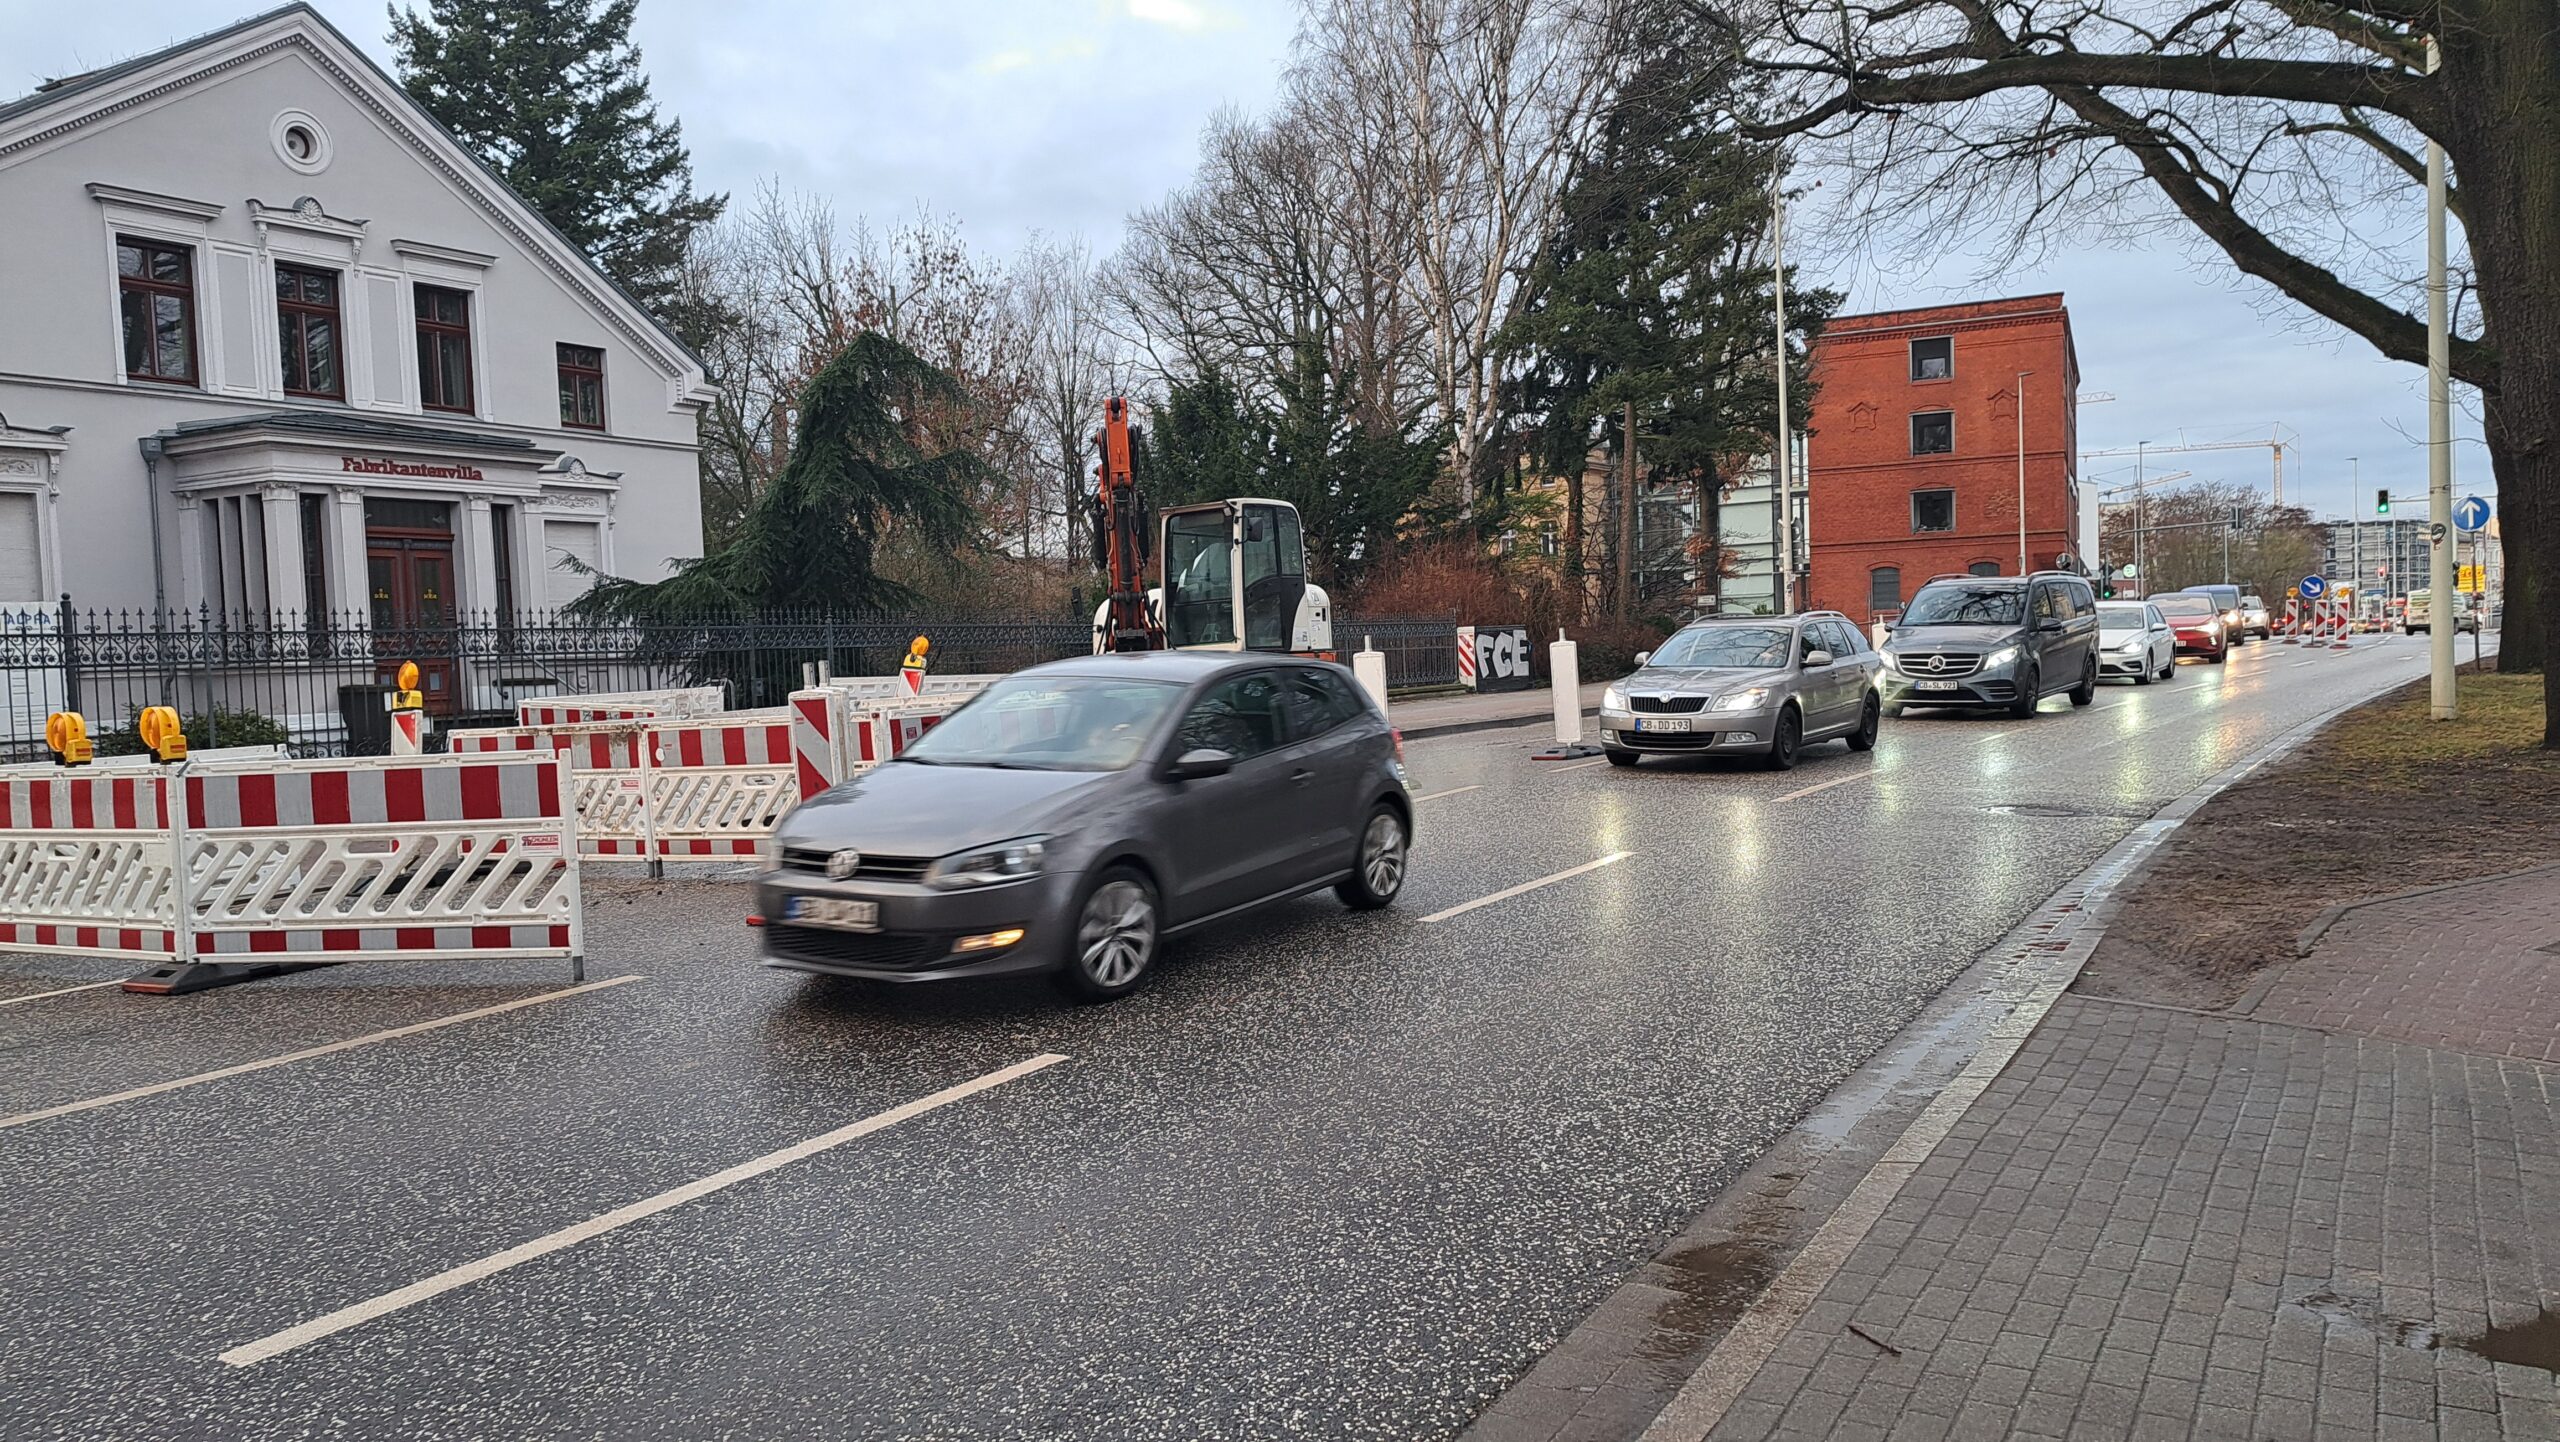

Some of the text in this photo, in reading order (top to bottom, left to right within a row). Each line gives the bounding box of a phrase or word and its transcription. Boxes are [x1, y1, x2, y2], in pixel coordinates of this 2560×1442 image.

[341, 457, 484, 481] Fabrikantenvilla
[1475, 629, 1530, 679] FCE
[1641, 720, 1689, 730] CB DD 193
